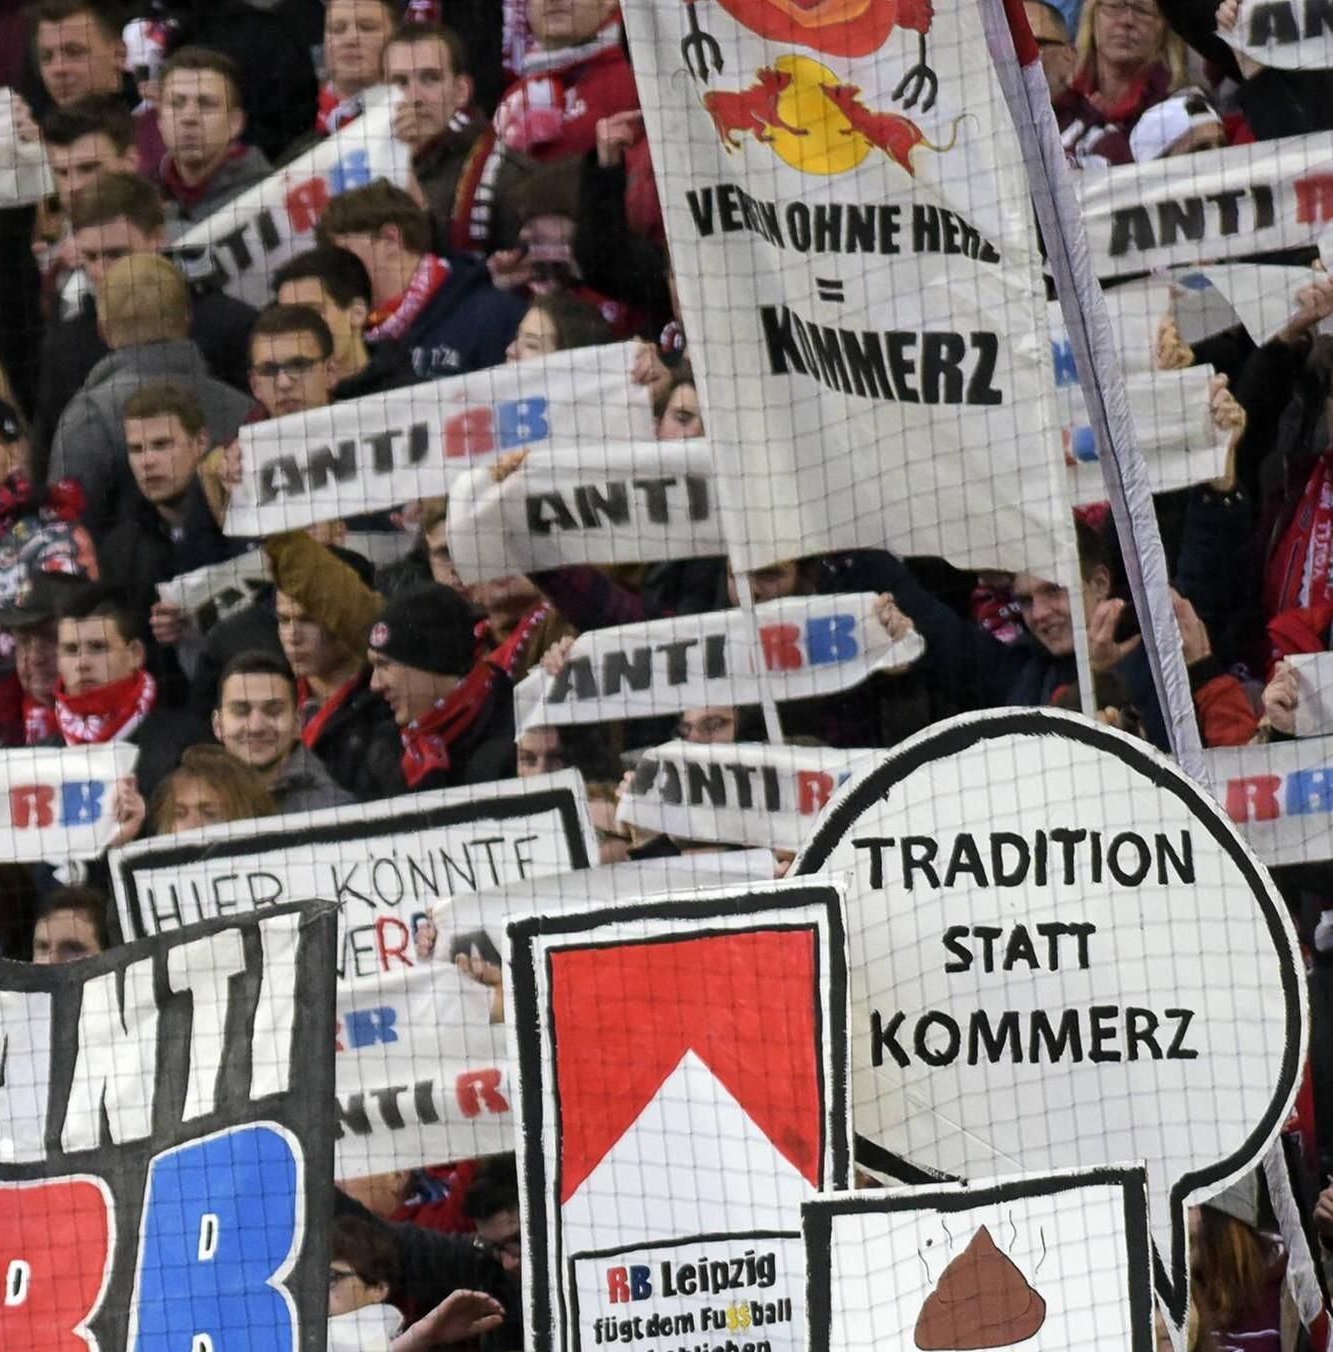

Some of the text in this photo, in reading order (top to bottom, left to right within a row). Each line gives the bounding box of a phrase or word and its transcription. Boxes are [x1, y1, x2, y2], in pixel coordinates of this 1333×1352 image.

[786, 201, 901, 254] OHNE
[1108, 184, 1275, 257] ANTI
[760, 303, 1003, 406] KOMMERZ
[258, 394, 551, 503] ANTI RB
[526, 476, 711, 535] ANTI
[547, 613, 859, 703] ANTI RB
[9, 780, 105, 829] RB
[851, 828, 1197, 892] TRADITION
[941, 920, 1097, 974] STATT
[870, 1004, 1200, 1068] KOMMERZ
[606, 1249, 776, 1304] RB Leipzig
[594, 1312, 644, 1347] fügt
[645, 1308, 695, 1339] dem
